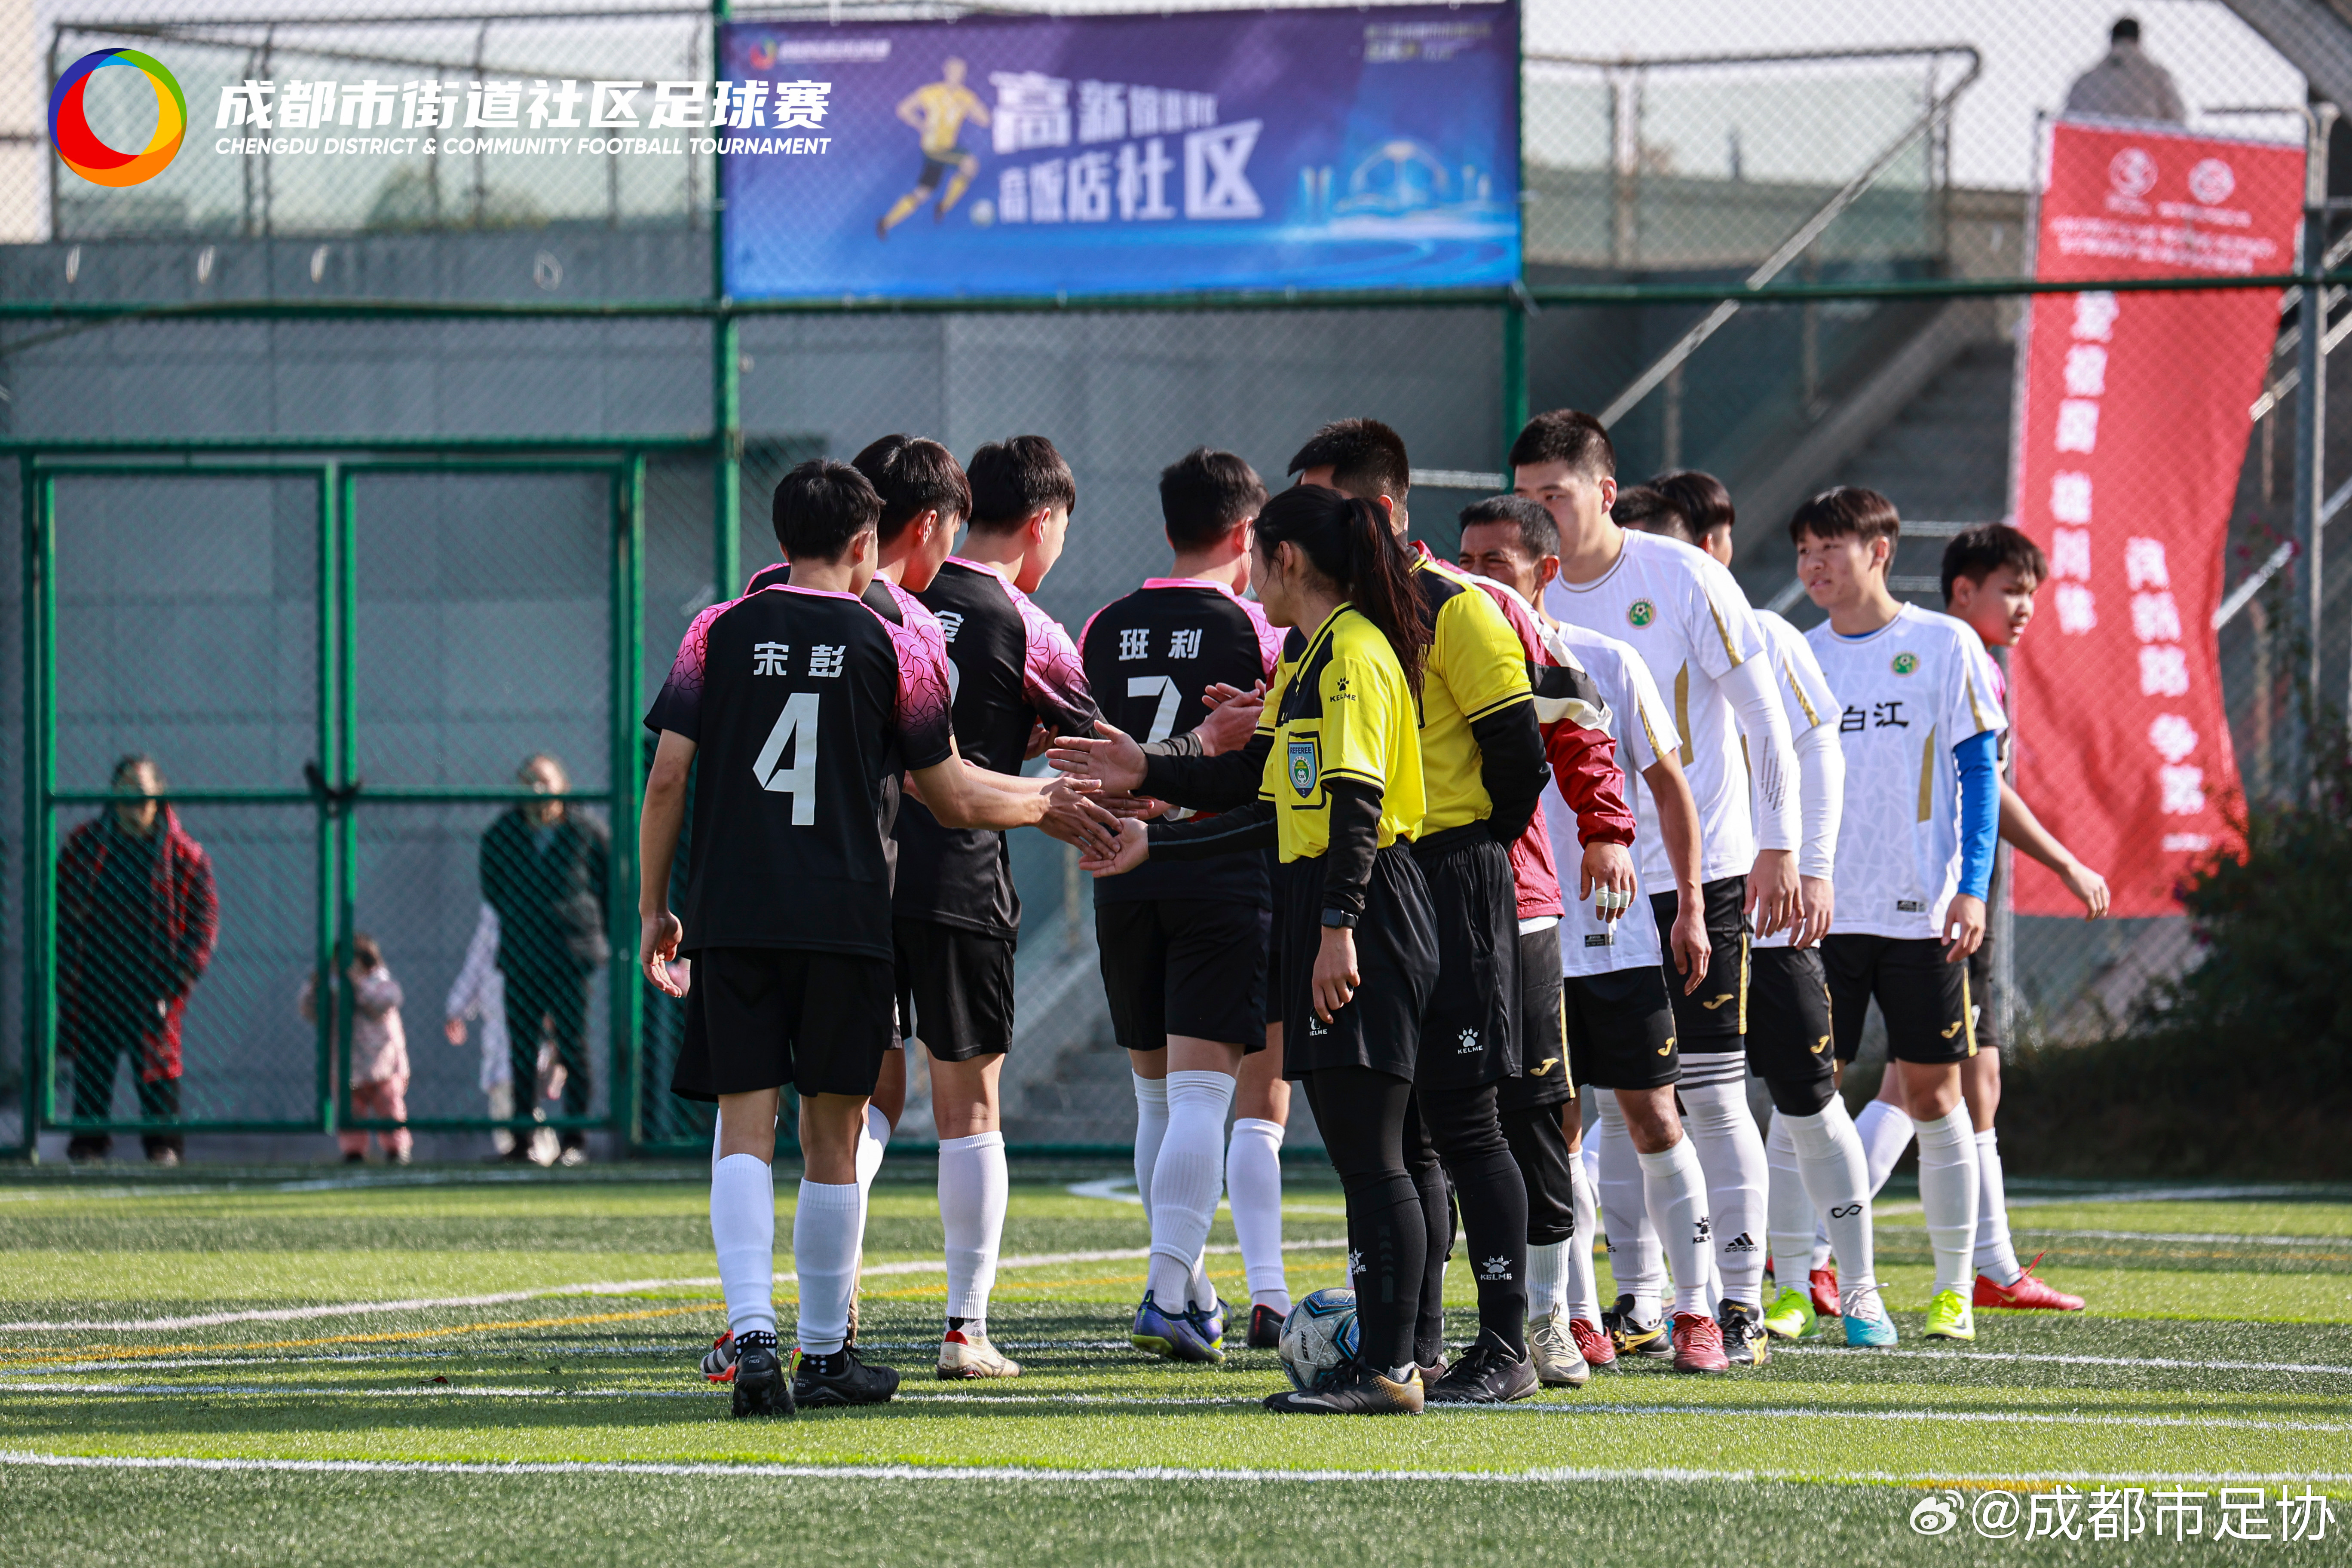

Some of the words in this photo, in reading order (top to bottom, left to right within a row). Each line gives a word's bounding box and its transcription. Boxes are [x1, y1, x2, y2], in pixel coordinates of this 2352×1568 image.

[1127, 675, 1182, 743] 7
[1330, 693, 1356, 702] KELME
[752, 692, 820, 826] 4
[1458, 1045, 1483, 1054] KELME
